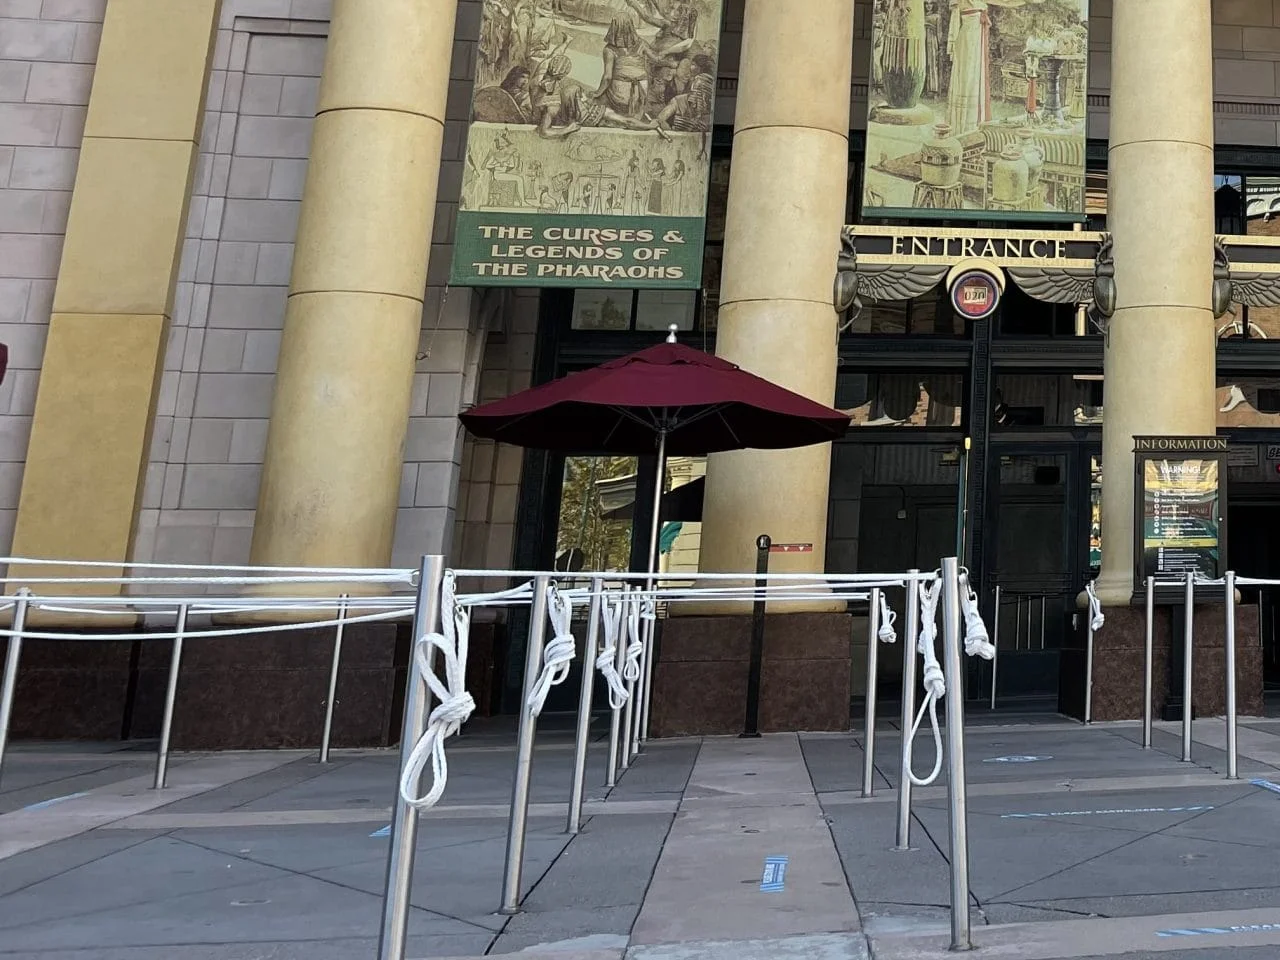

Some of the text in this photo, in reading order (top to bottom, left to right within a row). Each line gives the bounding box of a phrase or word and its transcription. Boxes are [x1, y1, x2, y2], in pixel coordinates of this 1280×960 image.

[478, 225, 685, 246] THE CURSES &
[491, 244, 669, 260] LEGENDS OF
[892, 236, 1066, 259] ENTRANCE
[472, 262, 684, 282] THE PHARAOHS
[1136, 439, 1227, 450] INFORMATION
